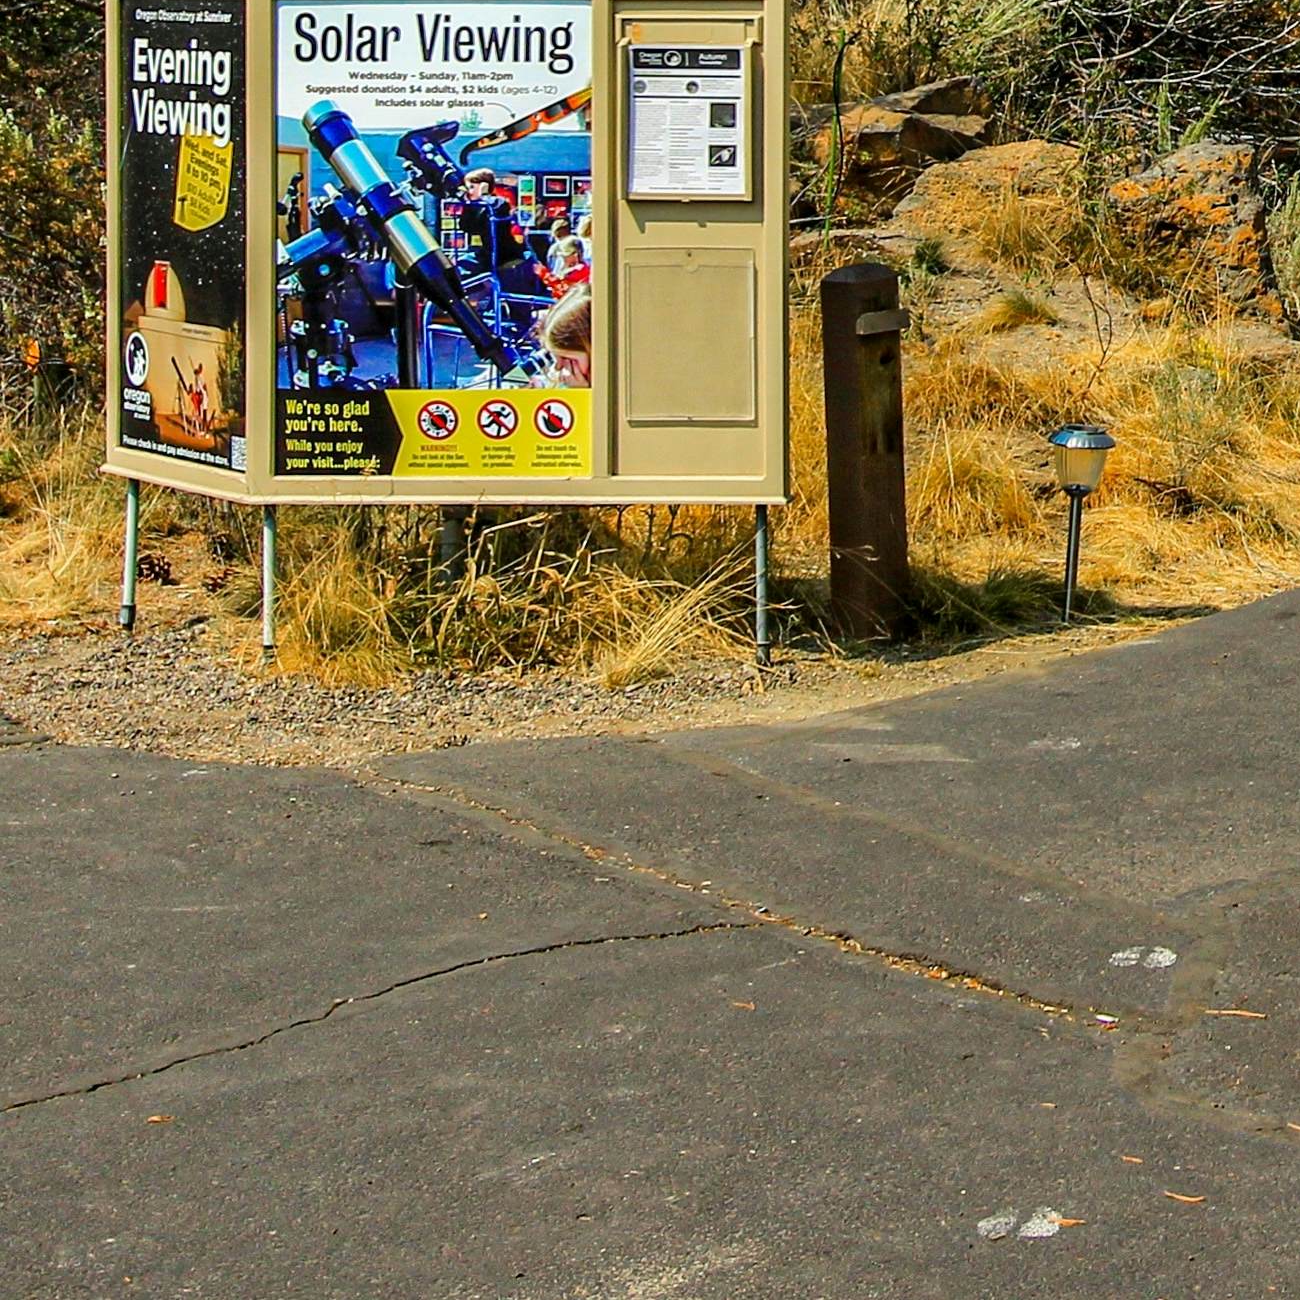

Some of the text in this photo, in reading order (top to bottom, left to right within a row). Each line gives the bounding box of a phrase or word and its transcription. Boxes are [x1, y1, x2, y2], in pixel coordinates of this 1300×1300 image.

[294, 12, 574, 74] Solar Viewing
[133, 37, 232, 95] Evening
[348, 71, 408, 81] Wednesday
[419, 71, 459, 81] Sunday,
[462, 71, 514, 81] 11am-2pm
[305, 85, 359, 95] Suggested
[361, 85, 406, 94] donation
[409, 85, 423, 94] $4
[425, 85, 459, 95] adults,
[461, 85, 475, 94] $2
[477, 85, 499, 94] kids
[501, 85, 530, 96] (ages
[375, 99, 485, 109] Includes solar glasses
[132, 88, 231, 148] Viewing
[123, 388, 150, 405] oregon
[285, 399, 370, 418] We're so glad
[285, 417, 363, 434] you're here.
[286, 439, 363, 454] While you enjoy
[286, 457, 309, 470] your
